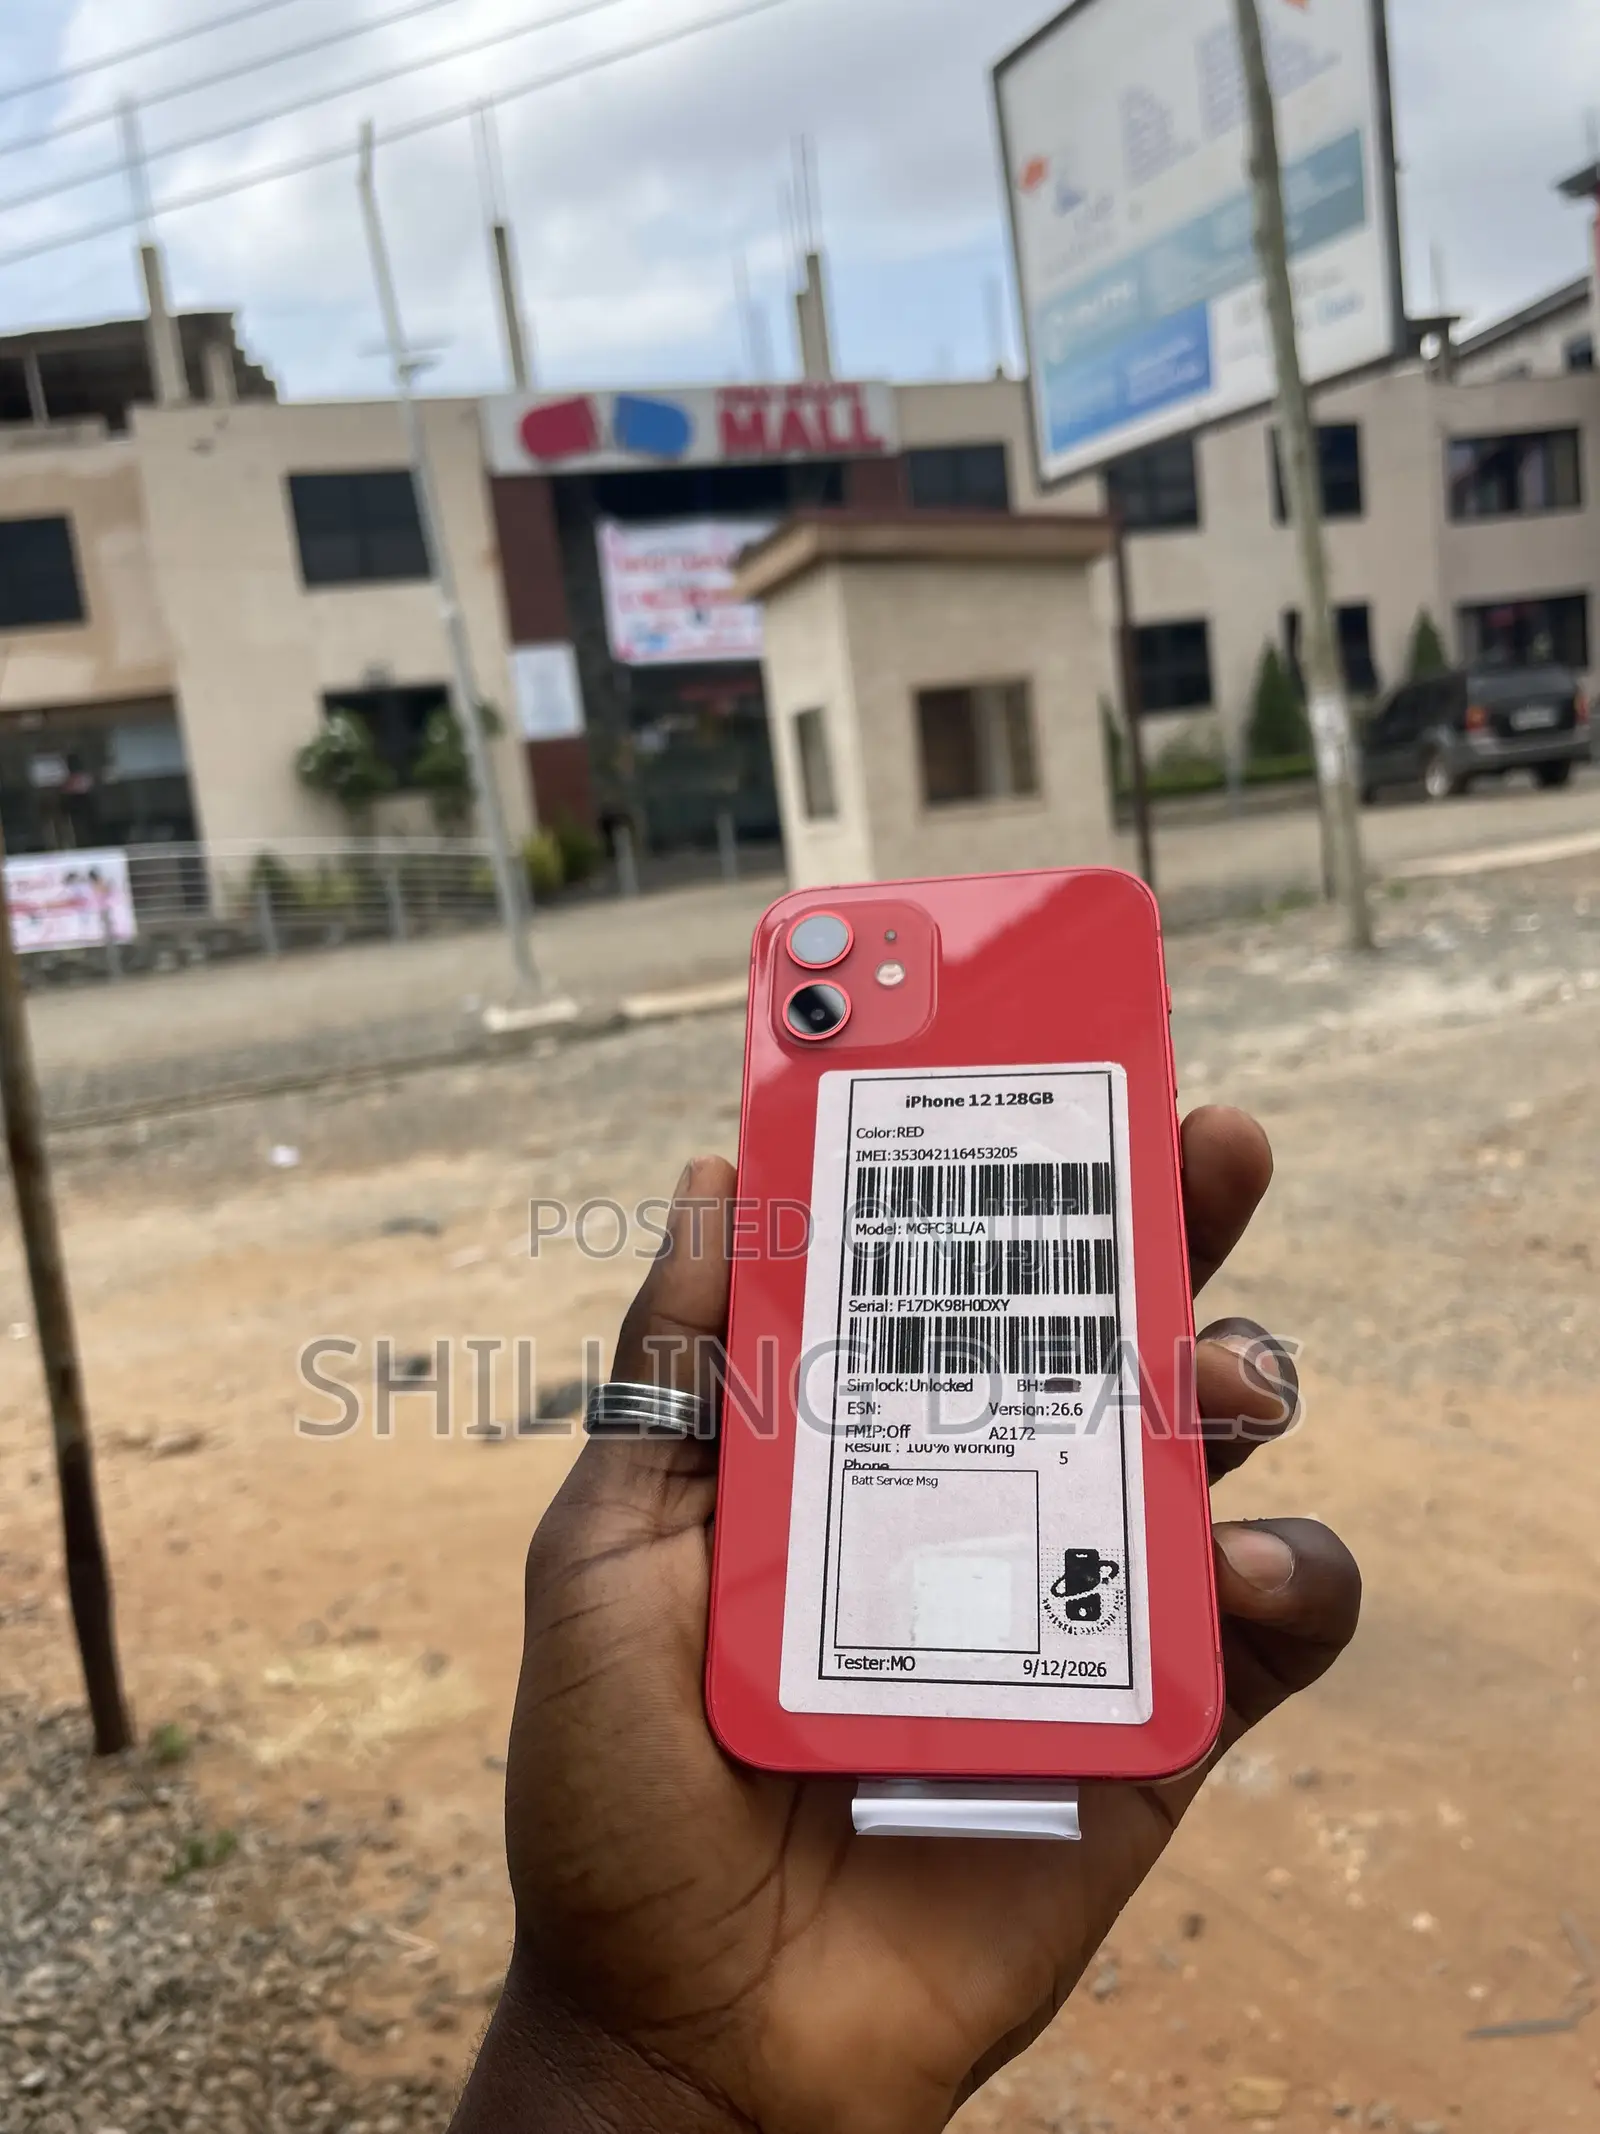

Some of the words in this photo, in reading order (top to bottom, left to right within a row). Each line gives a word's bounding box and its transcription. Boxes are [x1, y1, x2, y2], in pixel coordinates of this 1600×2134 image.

[721, 403, 884, 453] MALL
[905, 1095, 965, 1109] iPhone
[969, 1094, 991, 1107] 12
[994, 1092, 1054, 1106] 128GB
[856, 1126, 924, 1139] Color:RED
[856, 1146, 1018, 1162] IMEI:353042116453205
[856, 1222, 901, 1236] Model:
[906, 1221, 986, 1236] MGFC3LL/A
[849, 1299, 893, 1313] Serial:
[846, 1378, 973, 1393] Simlock:Unlocked
[847, 1401, 881, 1415] ESN:
[988, 1402, 1083, 1416] Version:26.6
[845, 1424, 911, 1439] FMIP:Off
[988, 1426, 1036, 1441] A2172
[844, 1459, 890, 1470] Phone
[1059, 1450, 1069, 1465] 5
[851, 1475, 875, 1486] Batt
[876, 1475, 914, 1487] Service
[916, 1475, 939, 1489] Msg
[834, 1654, 916, 1672] Tester:MO
[1022, 1658, 1107, 1679] 9/12/2026
